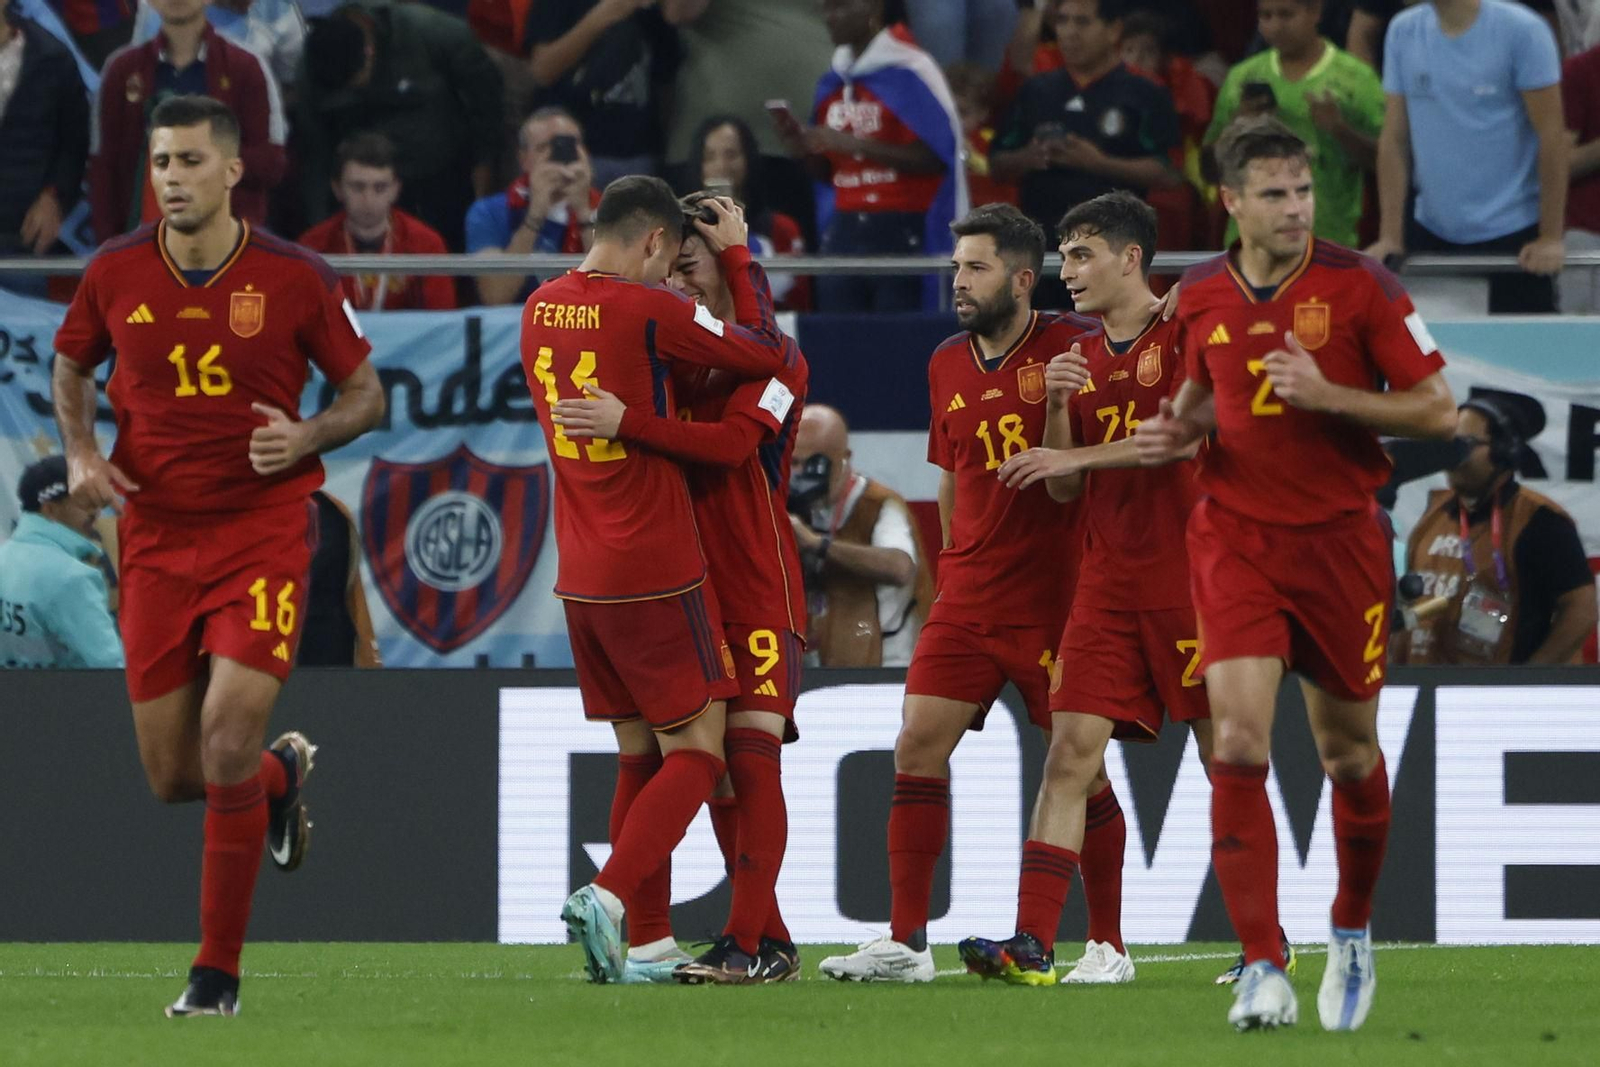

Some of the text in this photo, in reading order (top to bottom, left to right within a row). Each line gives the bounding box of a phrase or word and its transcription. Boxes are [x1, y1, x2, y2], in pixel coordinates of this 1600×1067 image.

[533, 301, 600, 329] FERRAN
[167, 344, 232, 397] 16
[1246, 359, 1284, 416] 2
[533, 346, 627, 462] 11
[975, 413, 1029, 471] 18
[247, 577, 296, 636] 16
[1363, 601, 1385, 663] 2
[748, 629, 780, 676] 9
